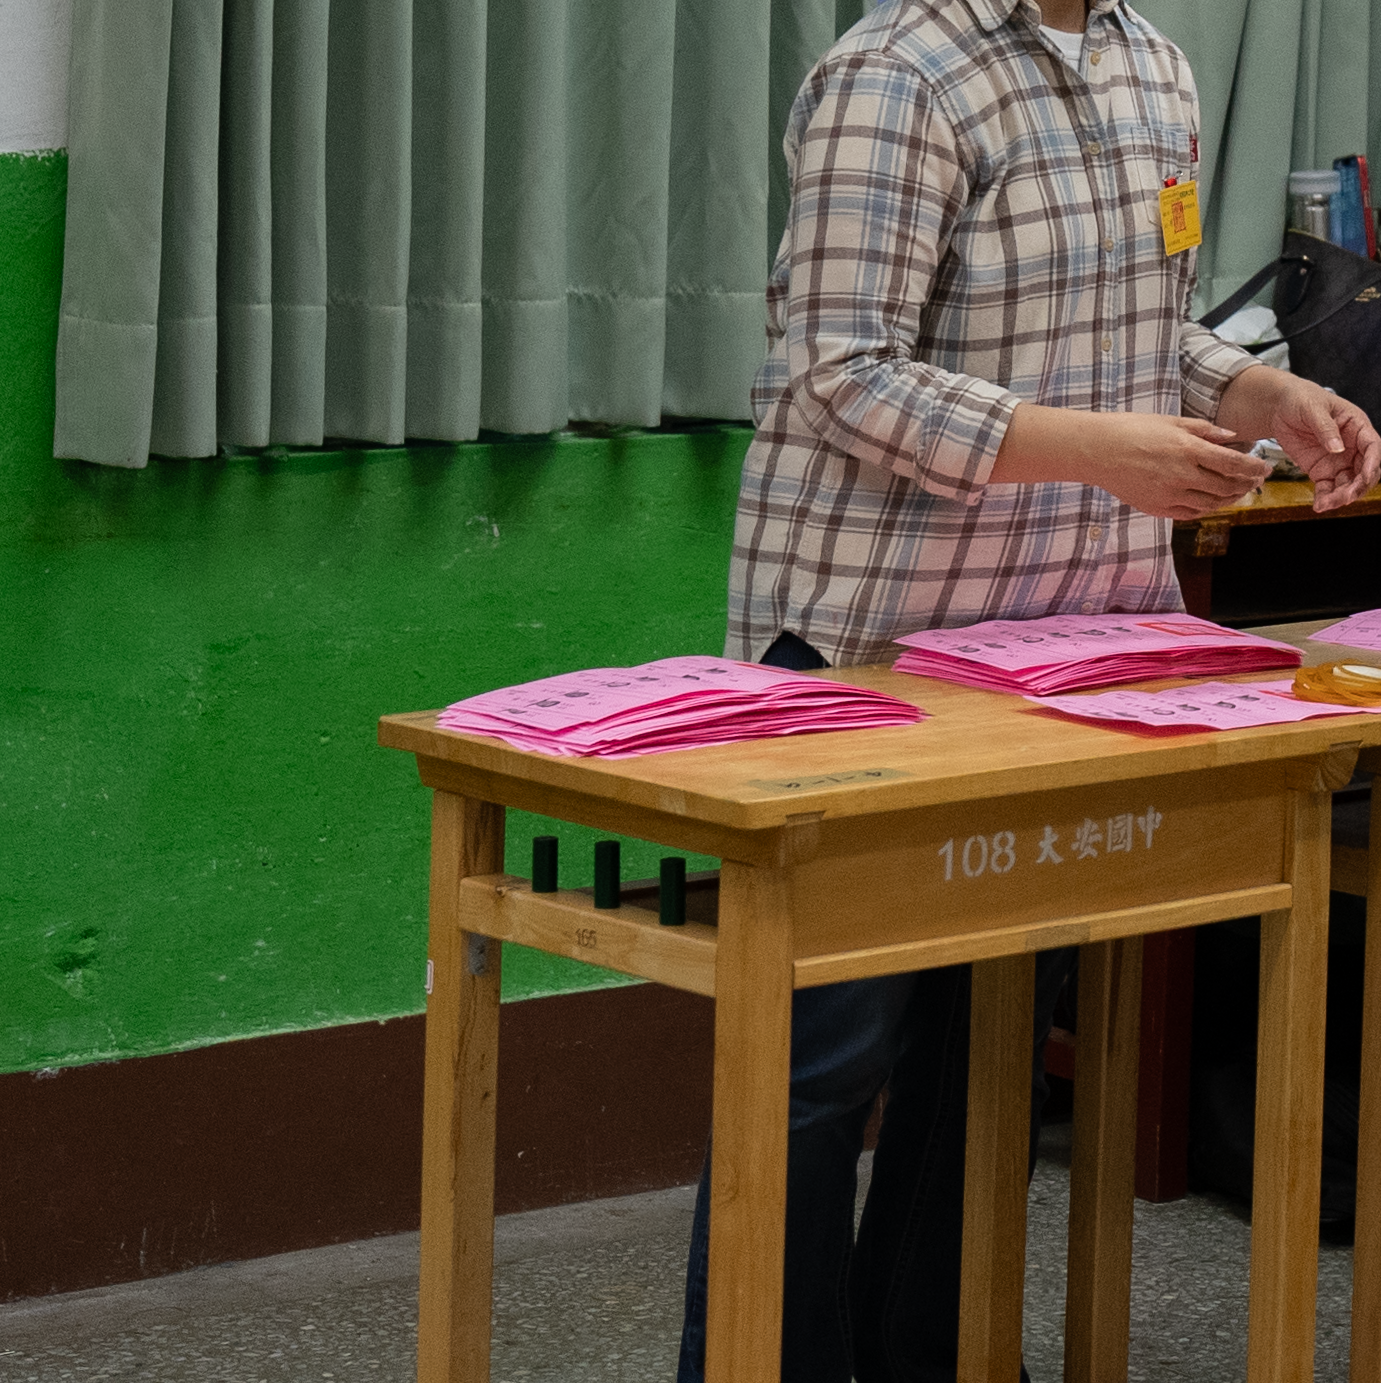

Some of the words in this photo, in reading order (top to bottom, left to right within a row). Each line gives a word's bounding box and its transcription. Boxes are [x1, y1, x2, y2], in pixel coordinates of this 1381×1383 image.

[937, 829, 1017, 881] 108
[1036, 805, 1163, 865] 大安國中
